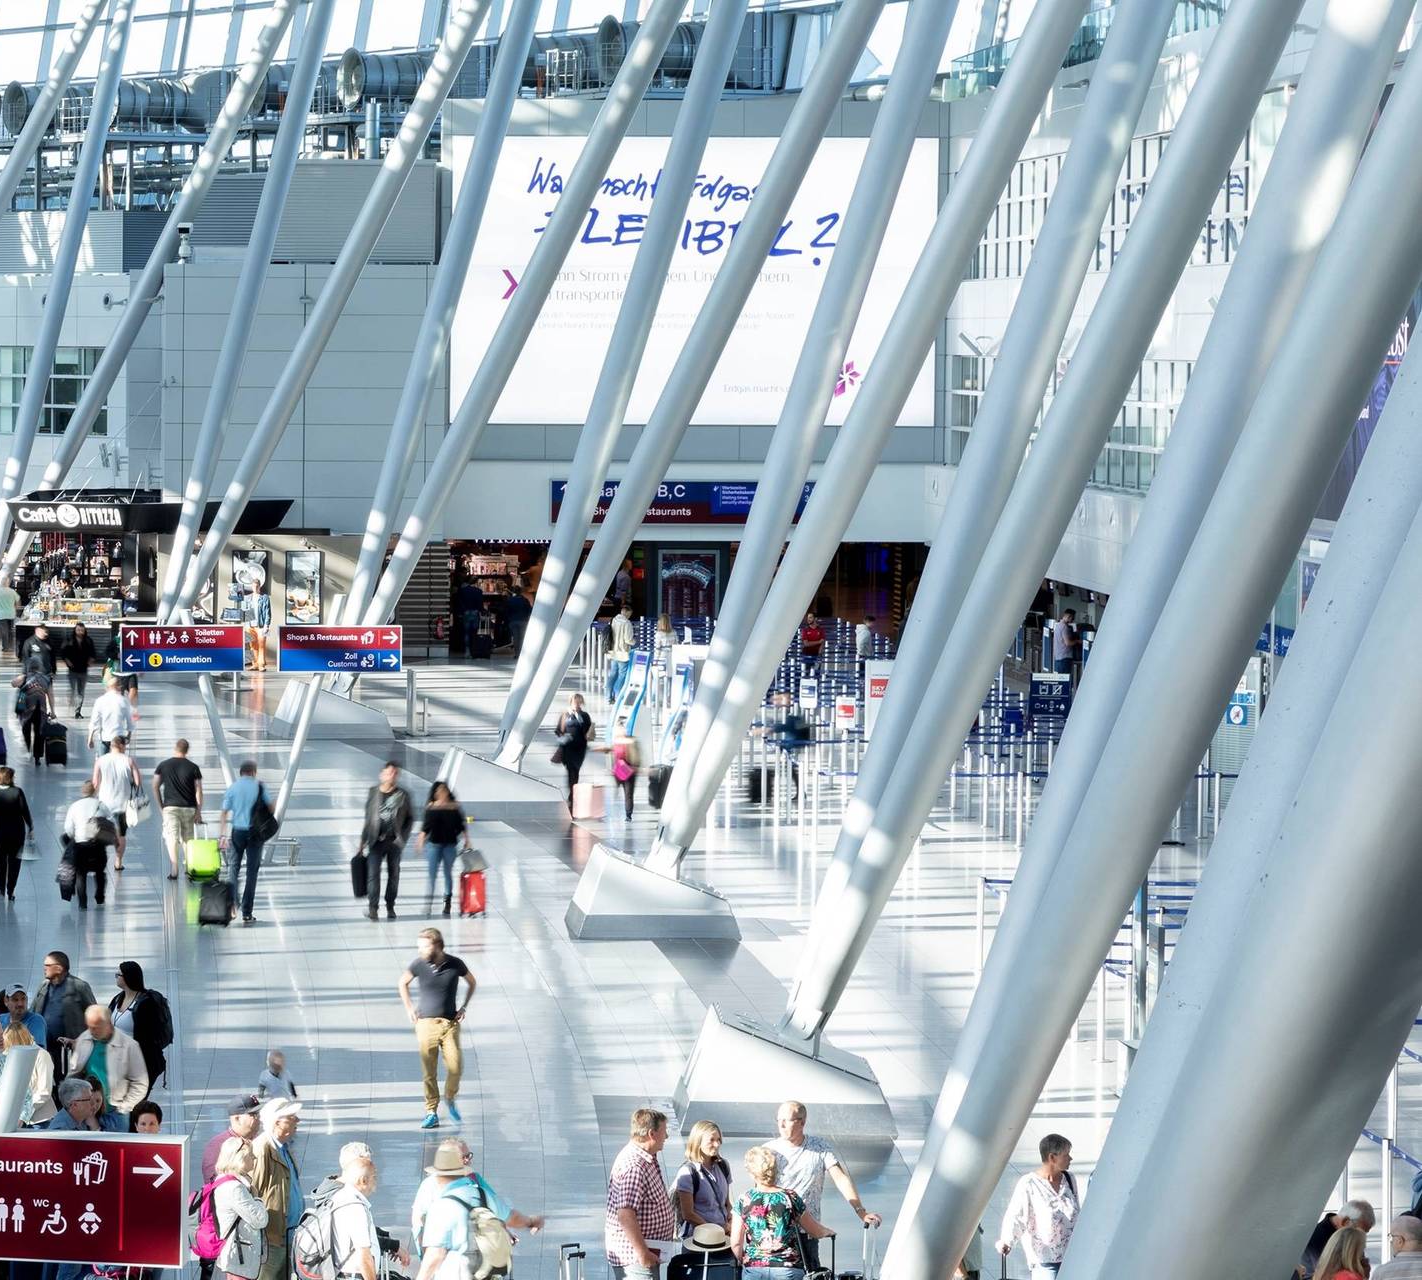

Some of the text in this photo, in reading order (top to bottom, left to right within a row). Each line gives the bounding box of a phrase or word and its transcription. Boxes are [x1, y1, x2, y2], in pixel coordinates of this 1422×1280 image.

[18, 506, 122, 526] Caffè RITAZZA
[646, 507, 692, 516] staurants
[286, 633, 309, 642] Shops
[309, 633, 316, 641] &
[165, 655, 213, 664] Information
[344, 652, 358, 660] Zoll
[327, 660, 358, 668] Customs
[32, 1198, 50, 1208] WC
